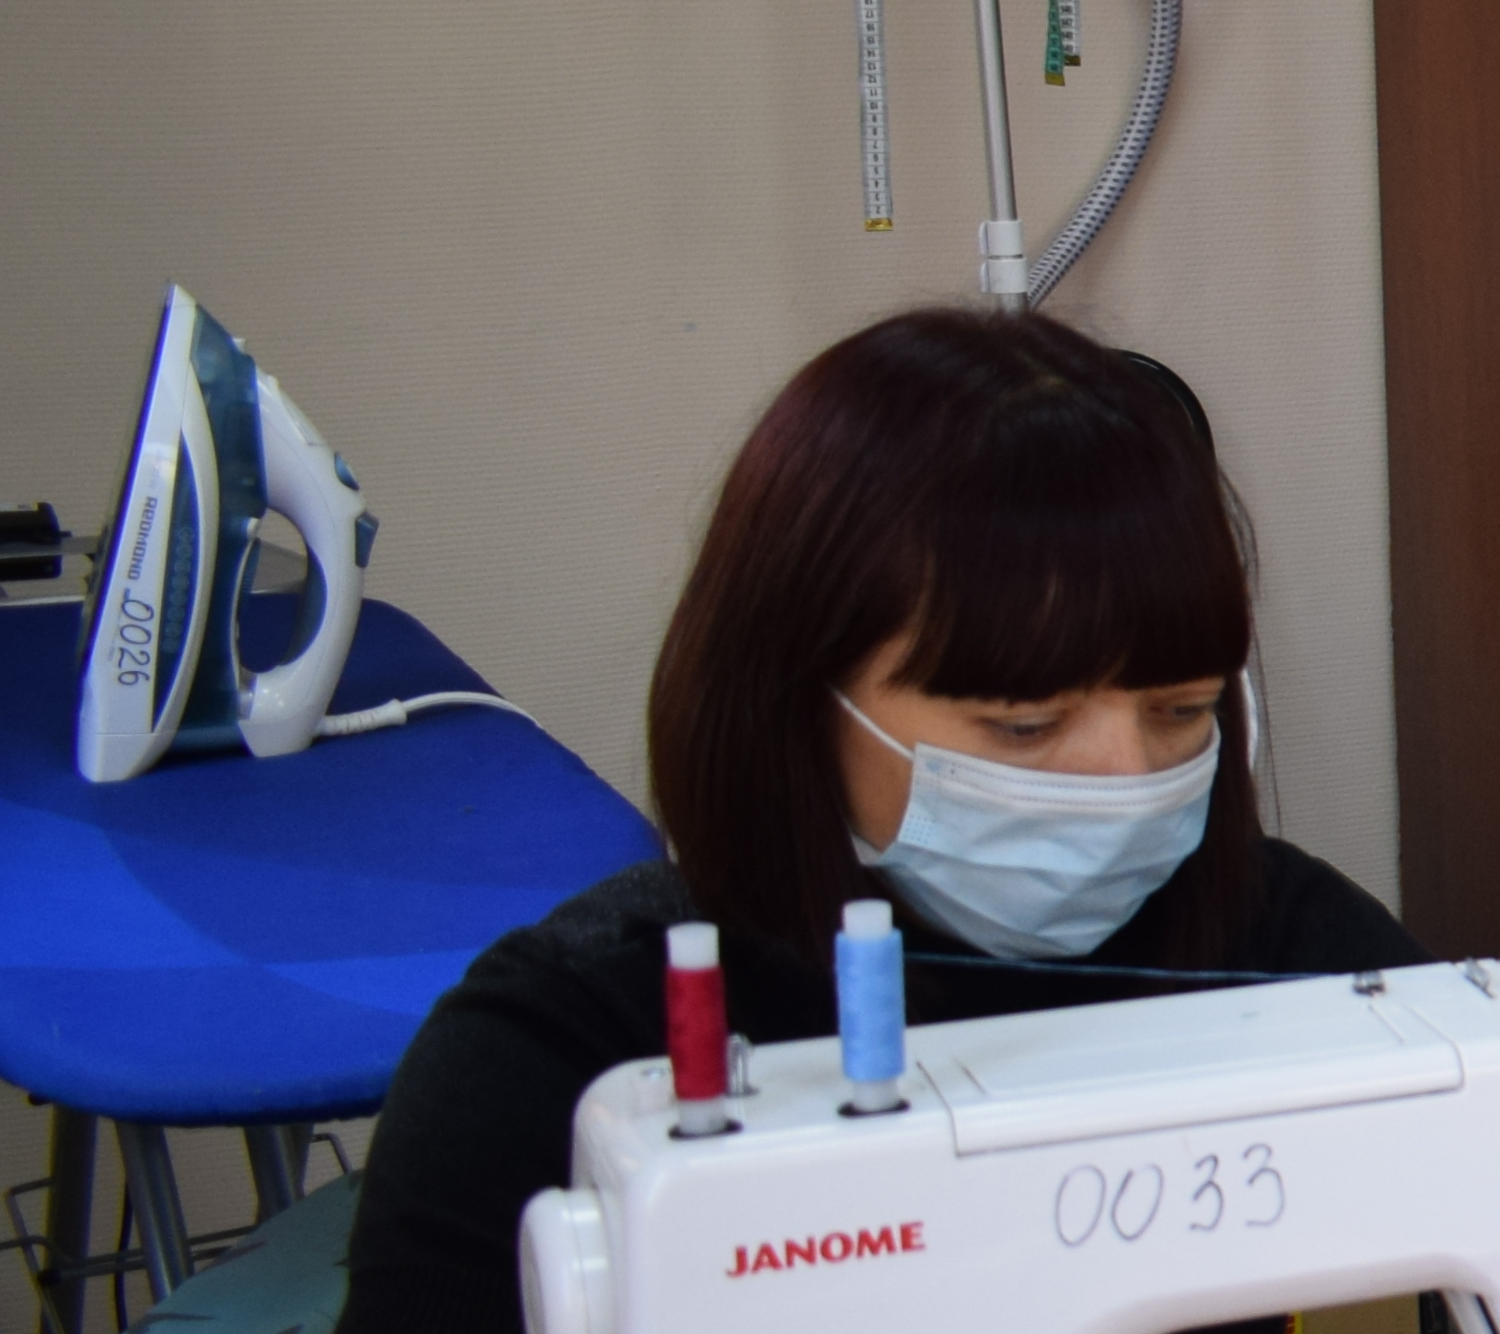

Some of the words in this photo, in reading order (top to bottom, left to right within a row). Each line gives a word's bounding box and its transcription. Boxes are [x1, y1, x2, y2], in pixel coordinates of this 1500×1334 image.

[117, 599, 154, 686] 0026
[1056, 1143, 1287, 1249] 0033
[725, 1222, 927, 1278] JANOME
